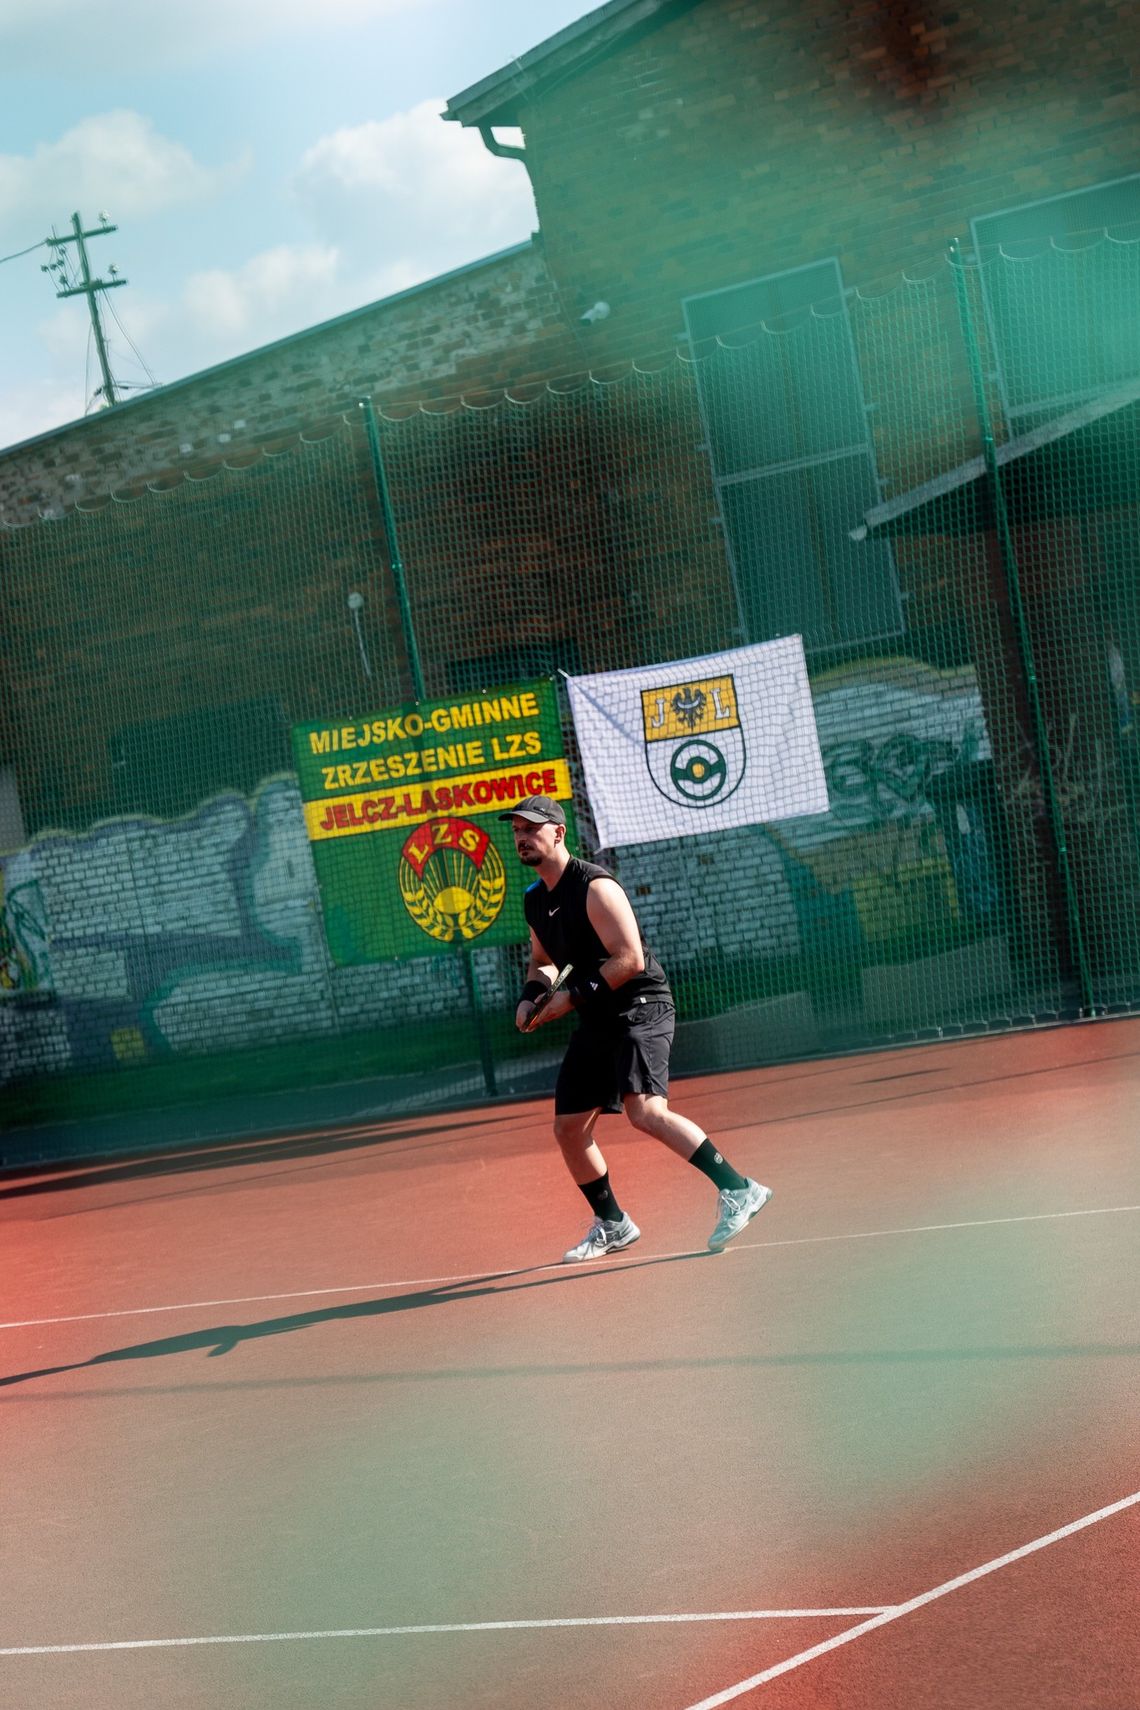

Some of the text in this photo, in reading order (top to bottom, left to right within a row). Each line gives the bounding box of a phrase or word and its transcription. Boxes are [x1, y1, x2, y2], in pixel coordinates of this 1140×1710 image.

[309, 692, 540, 755] MIEJSKO-GMINNE
[321, 731, 543, 791] ZRZESZENIE LZS
[320, 768, 558, 832] JELCZ-LASKOWICE
[408, 823, 480, 864] LZS
